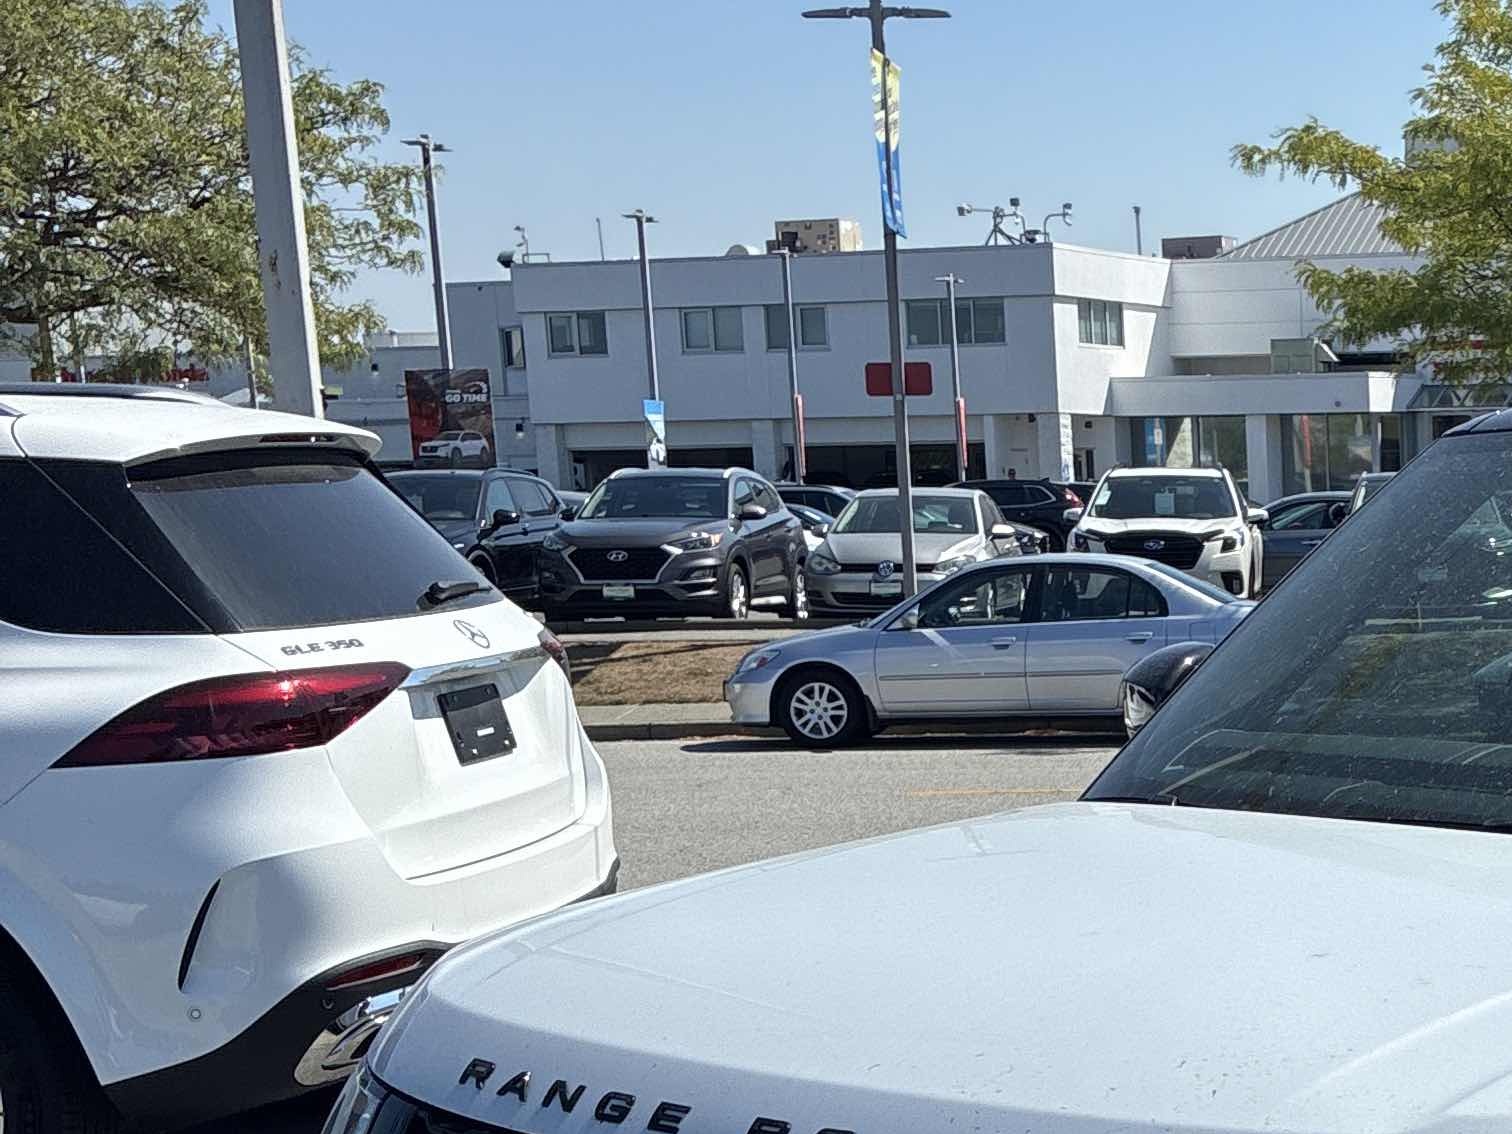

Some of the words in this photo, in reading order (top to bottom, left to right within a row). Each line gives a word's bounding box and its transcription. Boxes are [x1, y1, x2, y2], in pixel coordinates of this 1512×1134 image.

[445, 393, 461, 402] GO
[462, 393, 488, 402] TIME
[280, 643, 325, 656] GLE
[324, 638, 365, 650] 350
